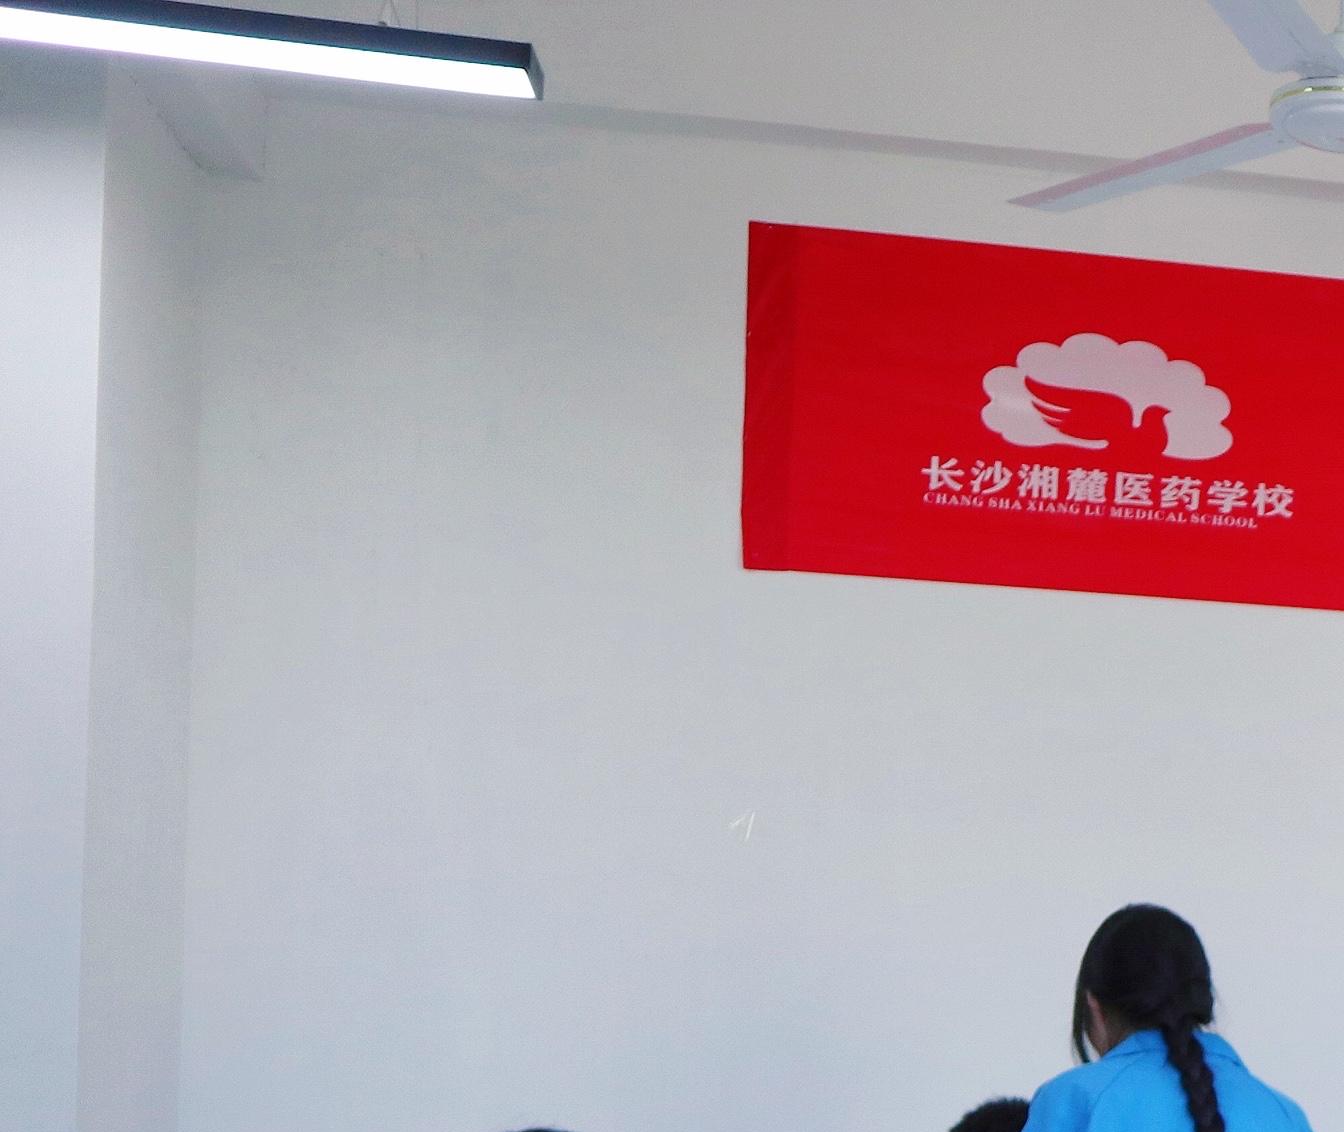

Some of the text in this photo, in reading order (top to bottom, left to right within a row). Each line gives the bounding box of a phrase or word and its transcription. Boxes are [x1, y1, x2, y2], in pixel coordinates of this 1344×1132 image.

[920, 455, 1295, 519] 长沙湘麓医药学校
[923, 492, 1258, 530] CHANG SHA XIANG LU MEDICAL SCHOOL
